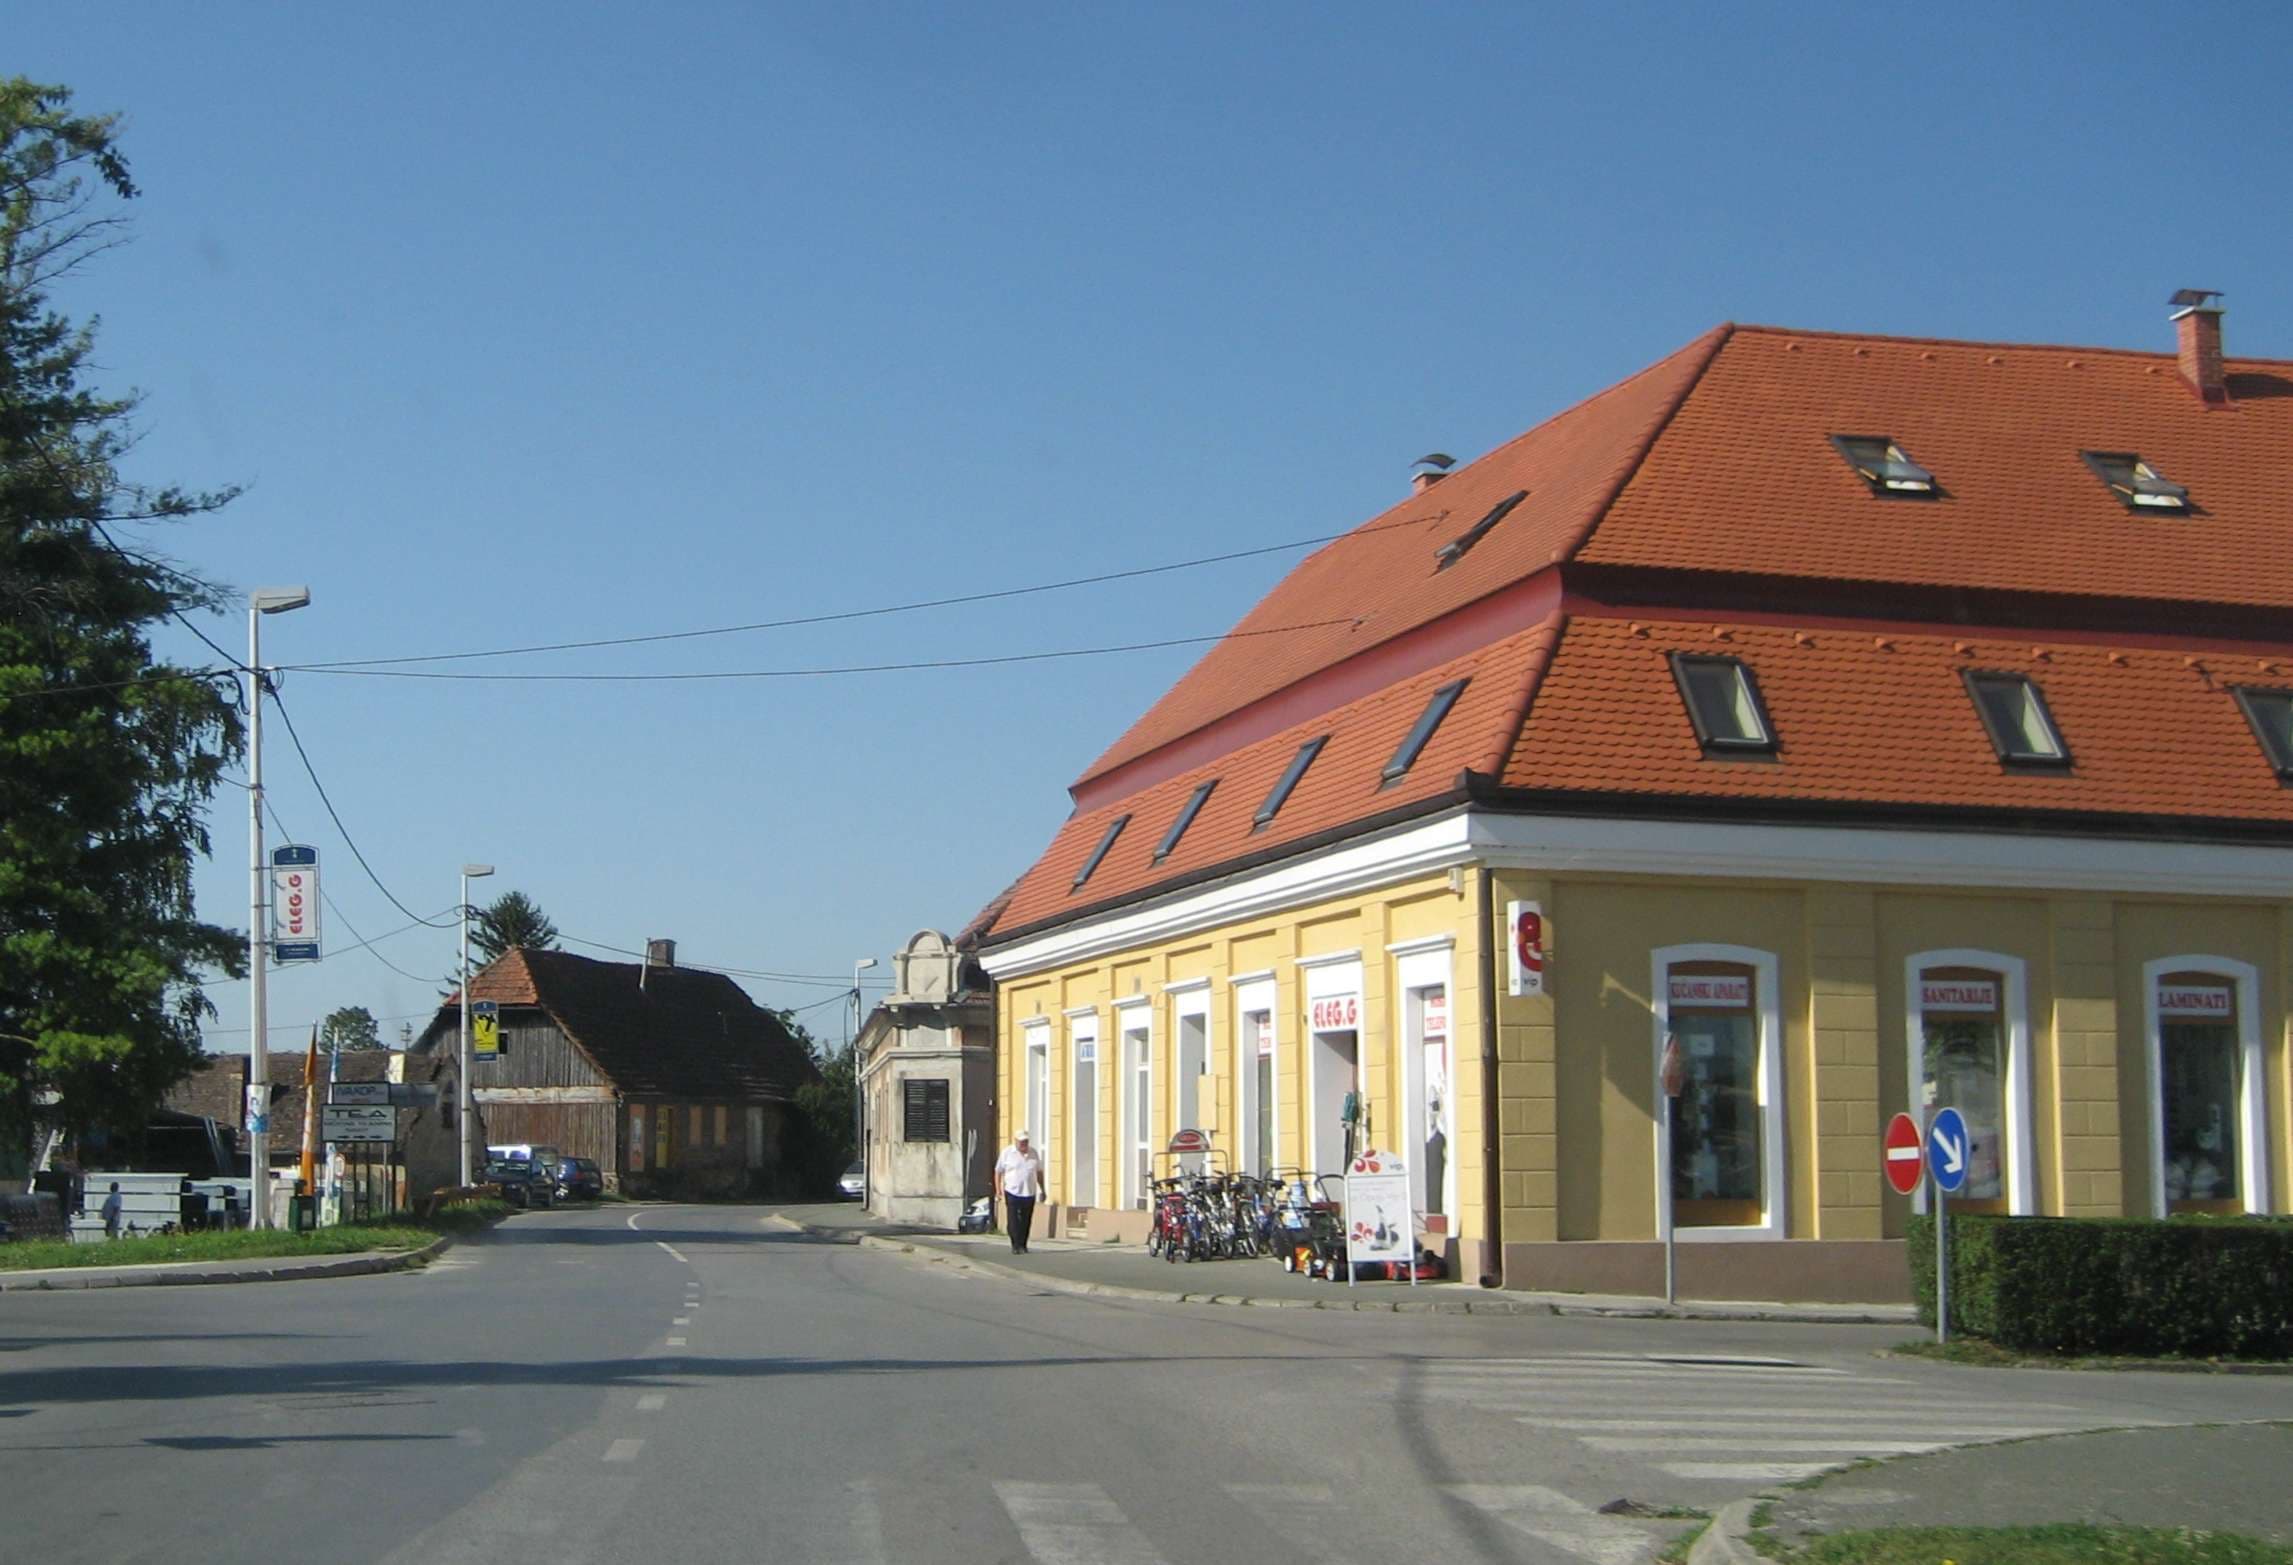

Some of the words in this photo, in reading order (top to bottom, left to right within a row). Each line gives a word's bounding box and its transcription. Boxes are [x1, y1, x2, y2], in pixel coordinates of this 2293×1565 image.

[2159, 991, 2226, 1009] LAMINATI
[1313, 998, 1357, 1028] ELEG.G
[329, 1109, 387, 1118] TEA
